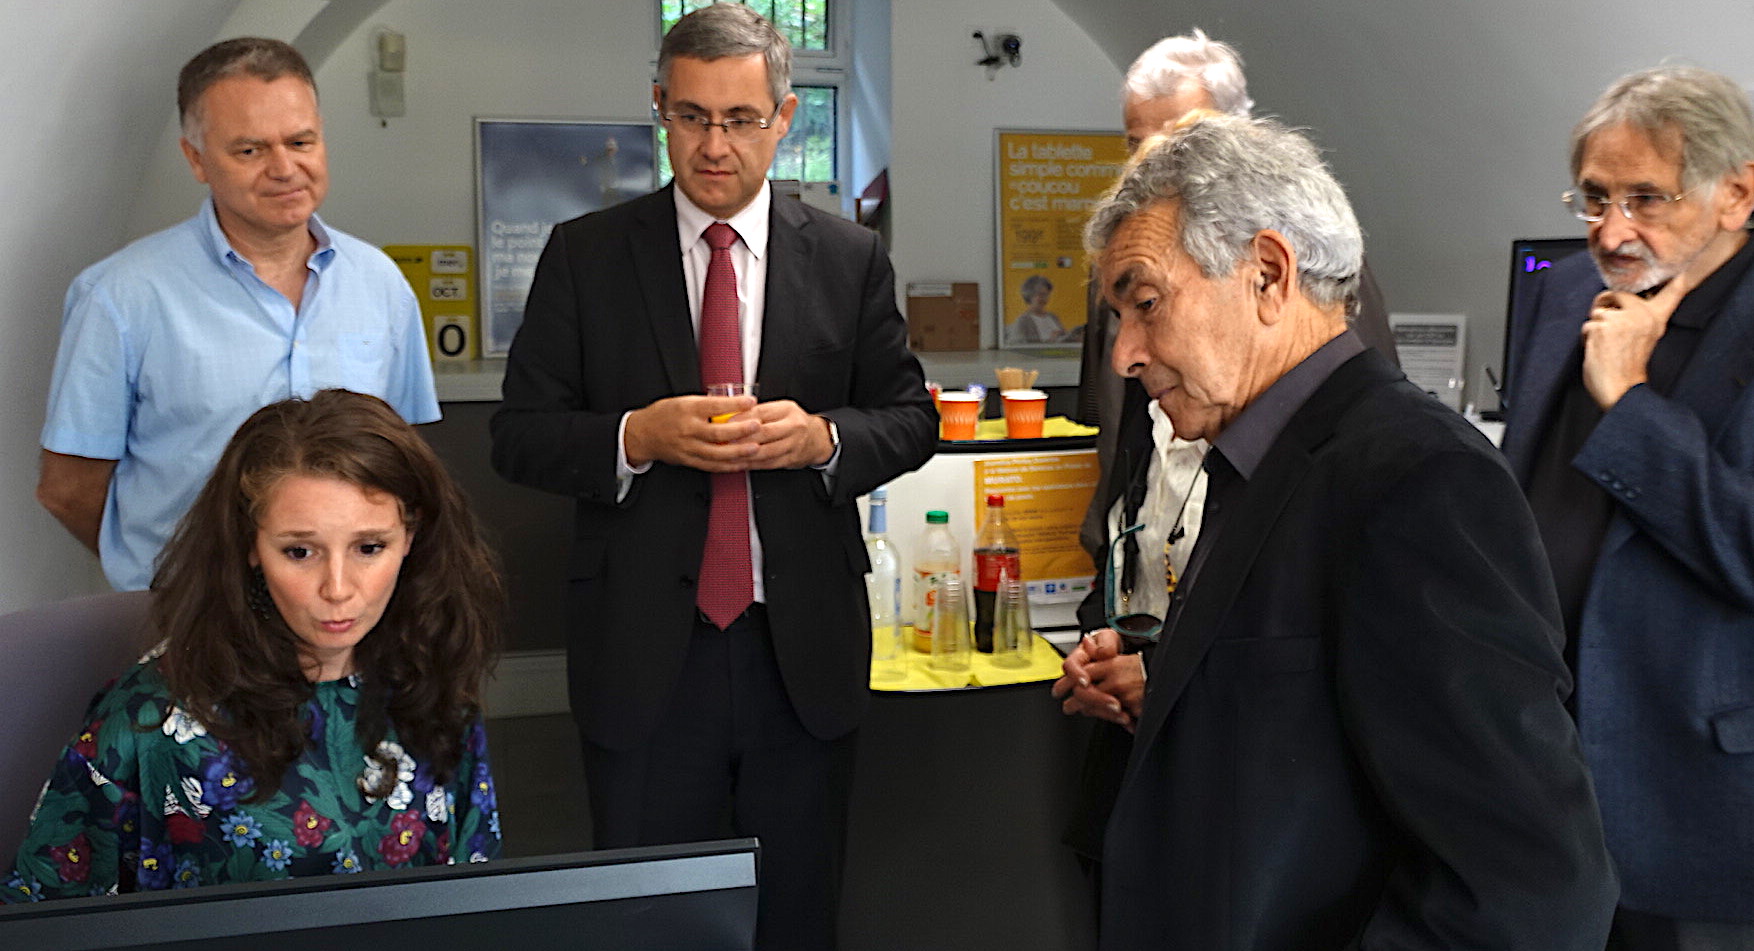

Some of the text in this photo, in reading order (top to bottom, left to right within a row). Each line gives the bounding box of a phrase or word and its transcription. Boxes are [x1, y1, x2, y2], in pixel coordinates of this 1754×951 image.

[1007, 141, 1094, 160] La tablette
[1008, 160, 1122, 180] simple comm
[1009, 195, 1048, 212] c'est
[490, 220, 540, 235] Quand
[491, 235, 505, 249] le
